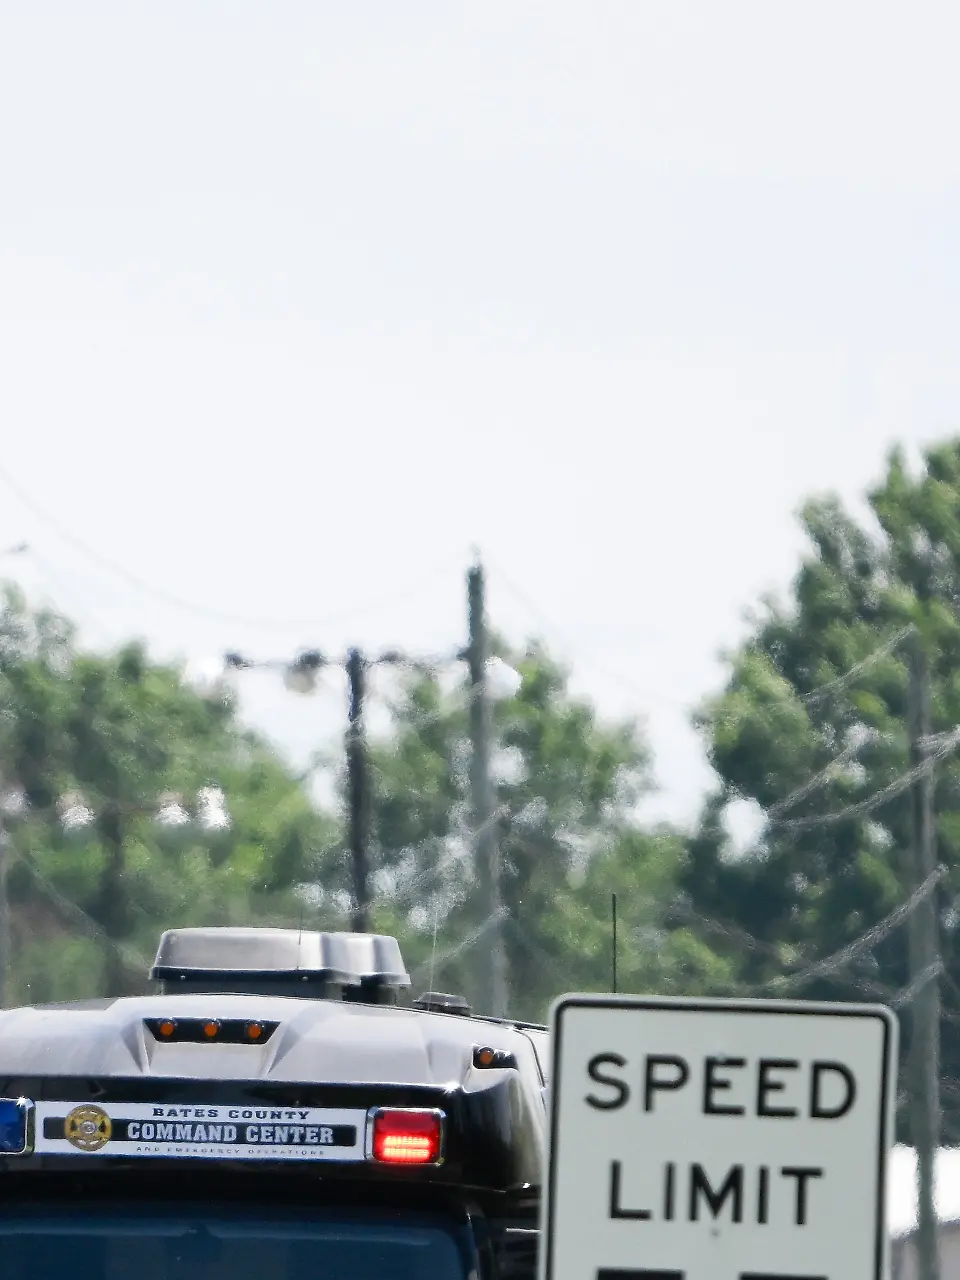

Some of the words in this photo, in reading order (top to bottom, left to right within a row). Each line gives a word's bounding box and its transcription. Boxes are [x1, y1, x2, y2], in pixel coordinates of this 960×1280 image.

[584, 1052, 857, 1121] SPEED
[127, 1121, 238, 1142] COMMAND
[245, 1125, 334, 1144] CENTER
[152, 1107, 219, 1118] BATES
[228, 1109, 310, 1120] COUNTY
[608, 1160, 825, 1226] LIMIT
